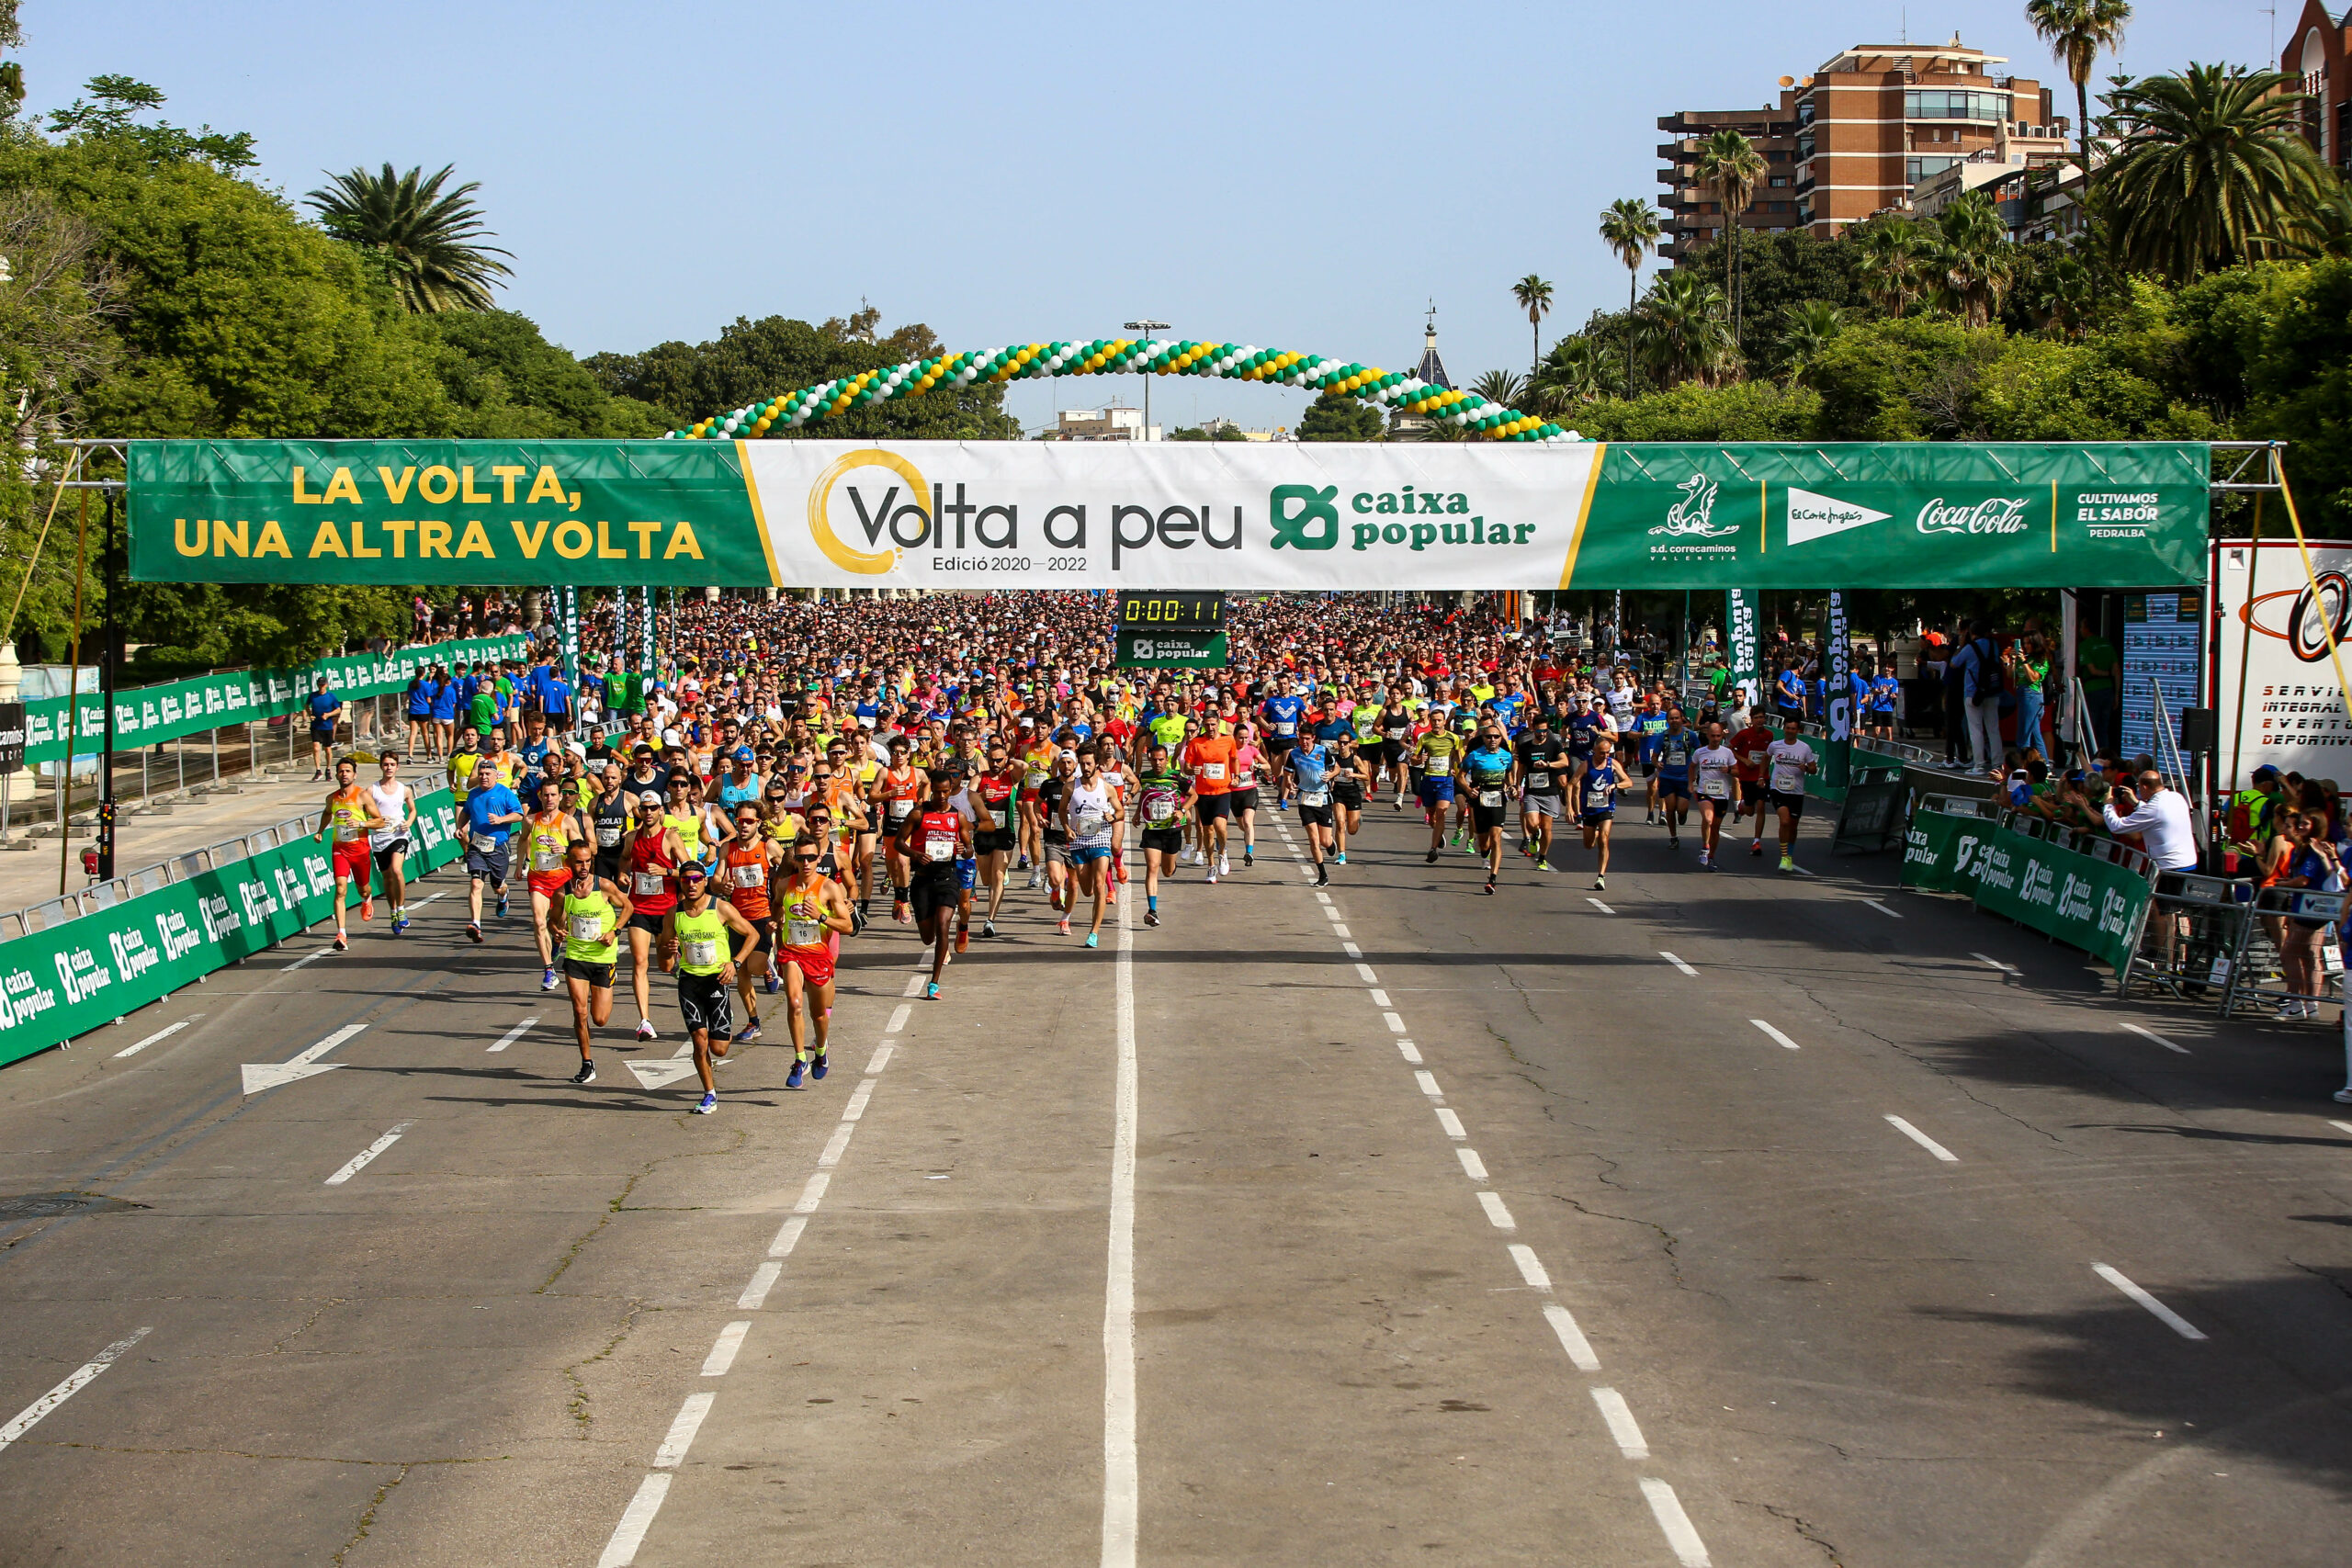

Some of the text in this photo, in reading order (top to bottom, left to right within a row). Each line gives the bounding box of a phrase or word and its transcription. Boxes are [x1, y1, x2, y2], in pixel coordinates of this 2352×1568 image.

[294, 466, 581, 512] LA VOLTA,
[1352, 486, 1470, 514] caixa
[2077, 493, 2158, 504] CULTIVAMOS
[846, 483, 1242, 570] Volta a peu
[1792, 507, 1862, 524] El Corte Inglés
[1917, 497, 2030, 535] Coca-Cola
[2077, 508, 2098, 522] EL
[175, 519, 705, 559] UNA ALTRA VOLTA
[1352, 515, 1536, 550] popular
[2089, 528, 2146, 538] PEDRALBA
[1650, 544, 1736, 553] s.d. correcaminos
[933, 557, 988, 571] Edició
[991, 557, 1031, 571] 2020
[1047, 557, 1087, 571] 2022
[1157, 640, 1191, 649] caixa
[1157, 649, 1210, 660] popular
[2262, 702, 2342, 713] INTEGRAL
[2262, 734, 2352, 746] DEPORTIV
[1992, 848, 2011, 868] caixa
[1987, 867, 2015, 890] popular
[2037, 864, 2054, 885] caixa
[252, 878, 267, 899] caixa
[2031, 884, 2055, 907] popular
[2073, 878, 2092, 900] caixa
[209, 893, 229, 915] caixa
[255, 893, 279, 923] popular
[2067, 899, 2094, 921] popular
[169, 908, 187, 931] caixa
[216, 905, 241, 938] popular
[122, 926, 144, 952] caixa
[173, 926, 201, 957] popular
[798, 930, 808, 938] 16
[70, 946, 95, 972] caixa
[129, 943, 160, 978] popular
[5, 967, 36, 995] caixa
[77, 964, 112, 1000] popular
[12, 986, 56, 1025] popular
